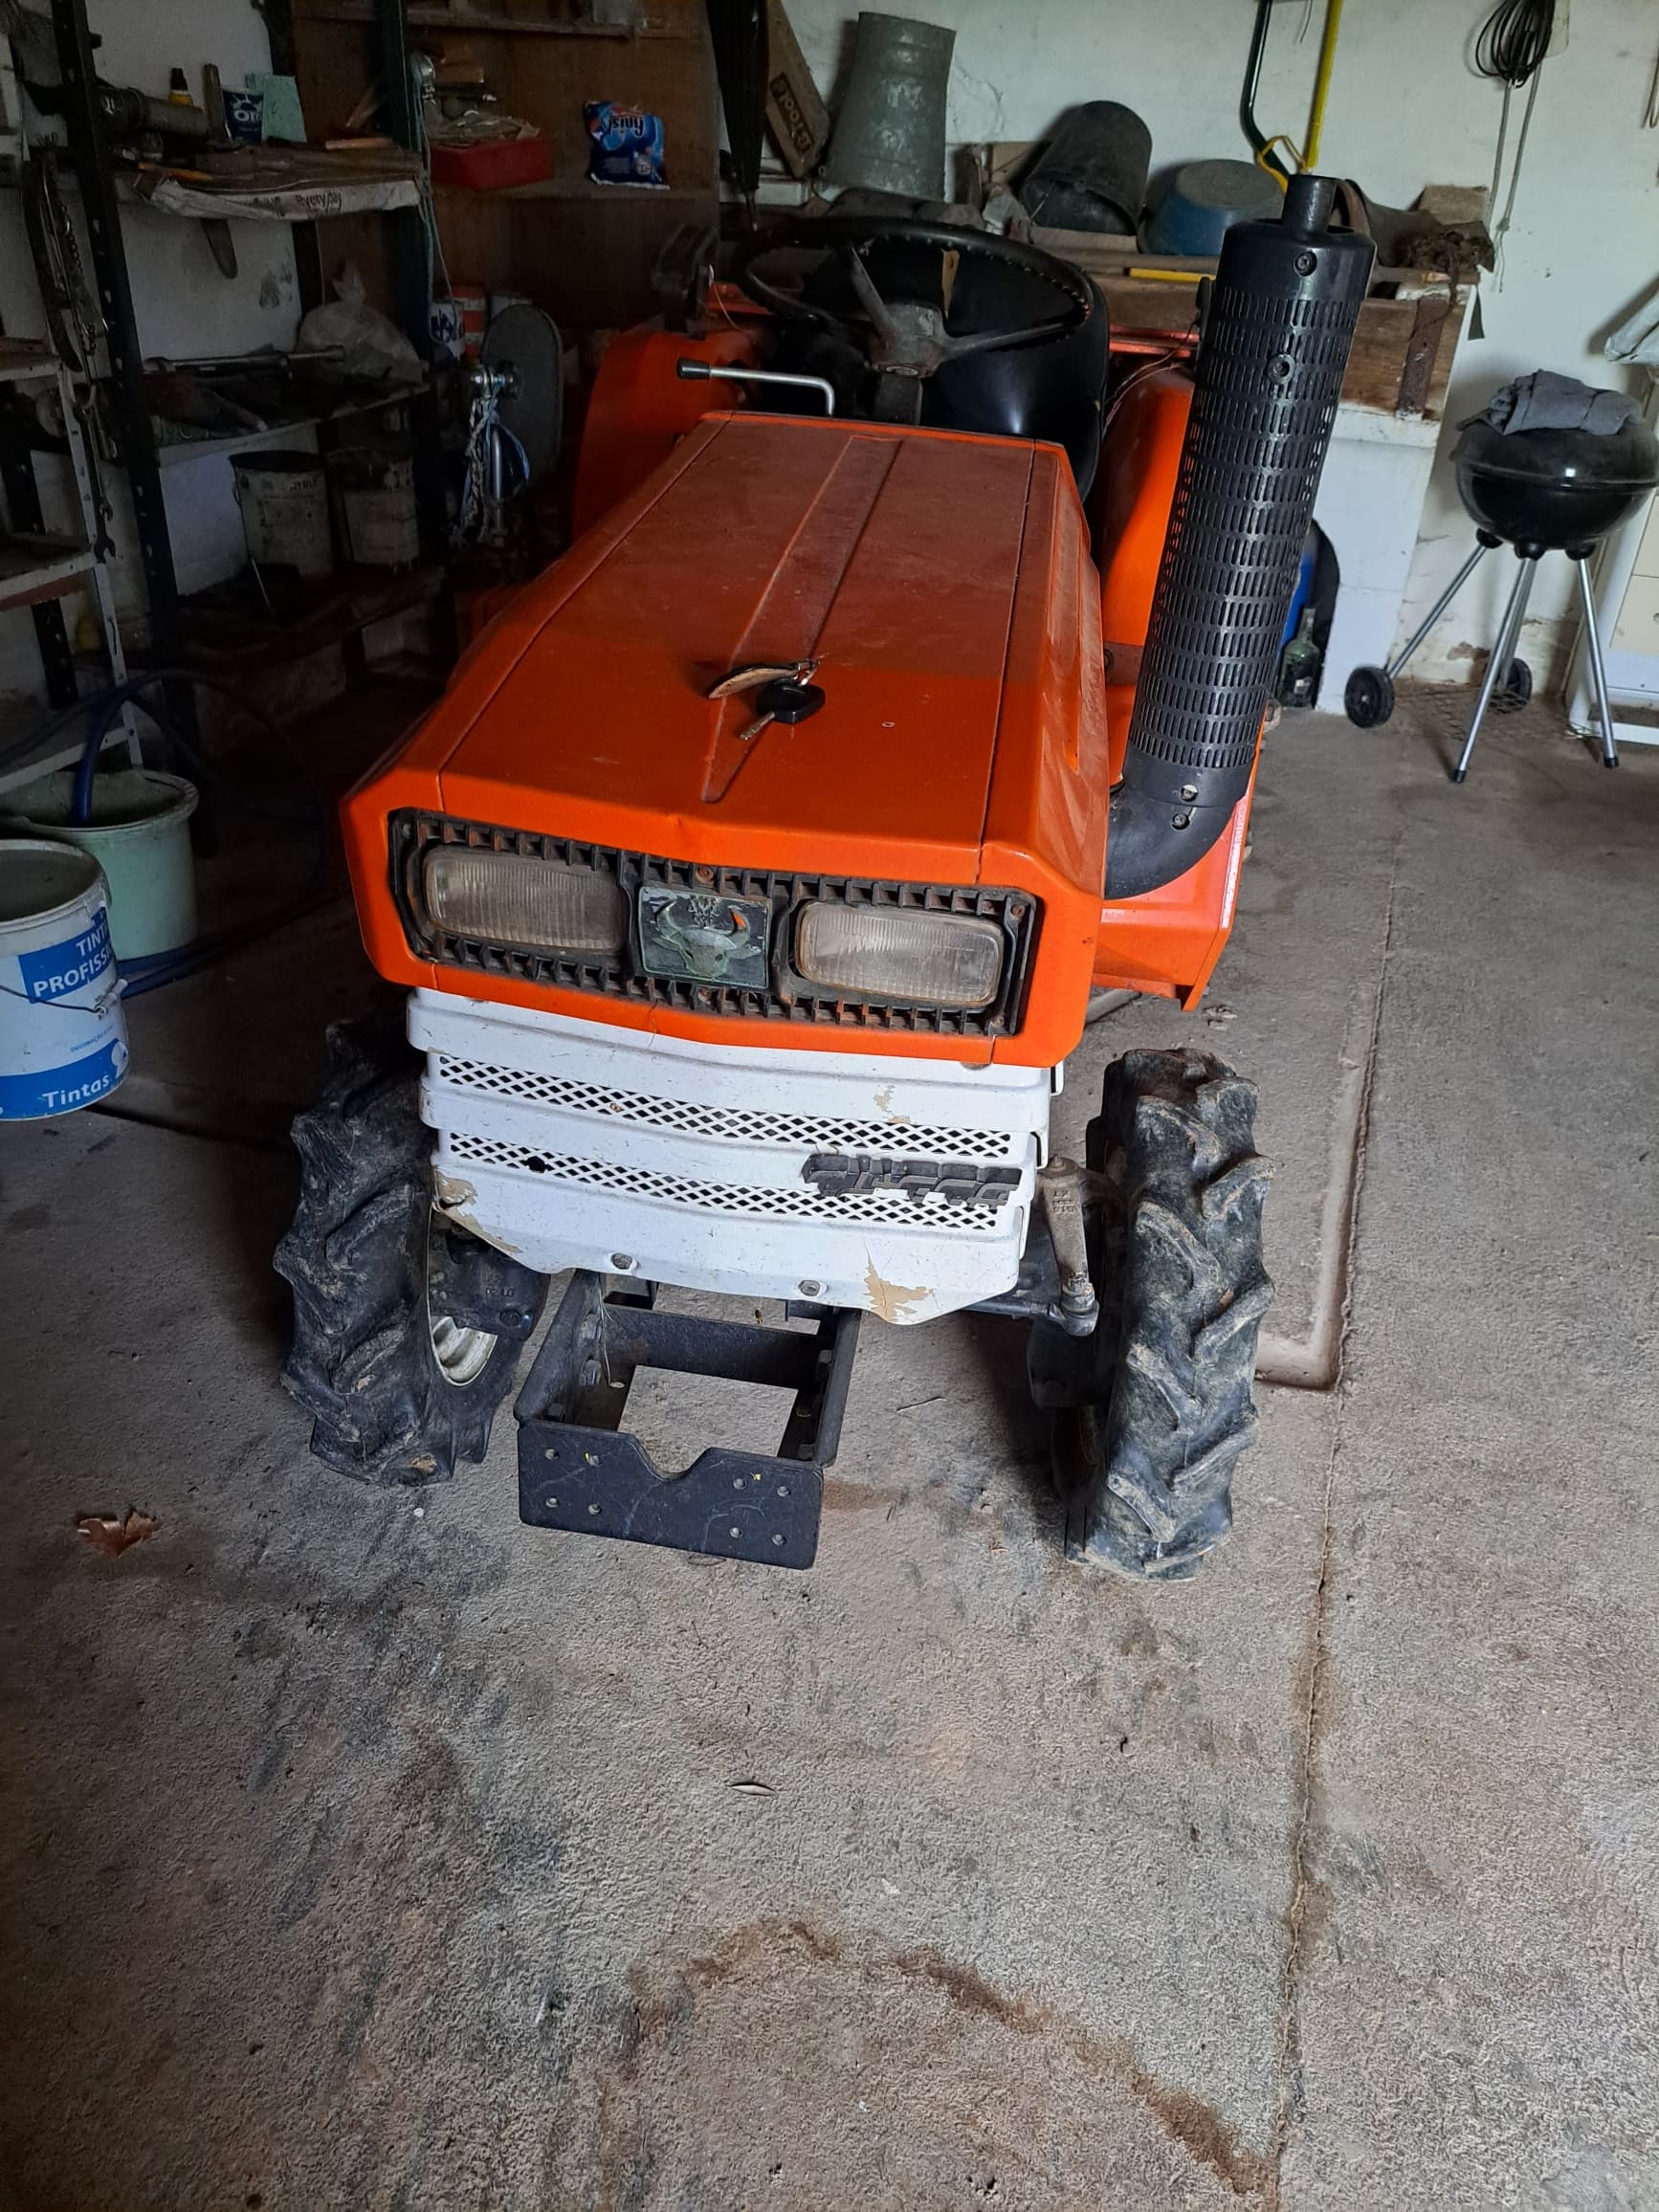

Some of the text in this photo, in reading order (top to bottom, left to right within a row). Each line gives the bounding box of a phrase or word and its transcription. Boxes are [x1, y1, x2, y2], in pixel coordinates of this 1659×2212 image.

[77, 924, 107, 957] TINT
[33, 946, 112, 997] PROFISSI
[42, 1074, 109, 1109] Tintas
